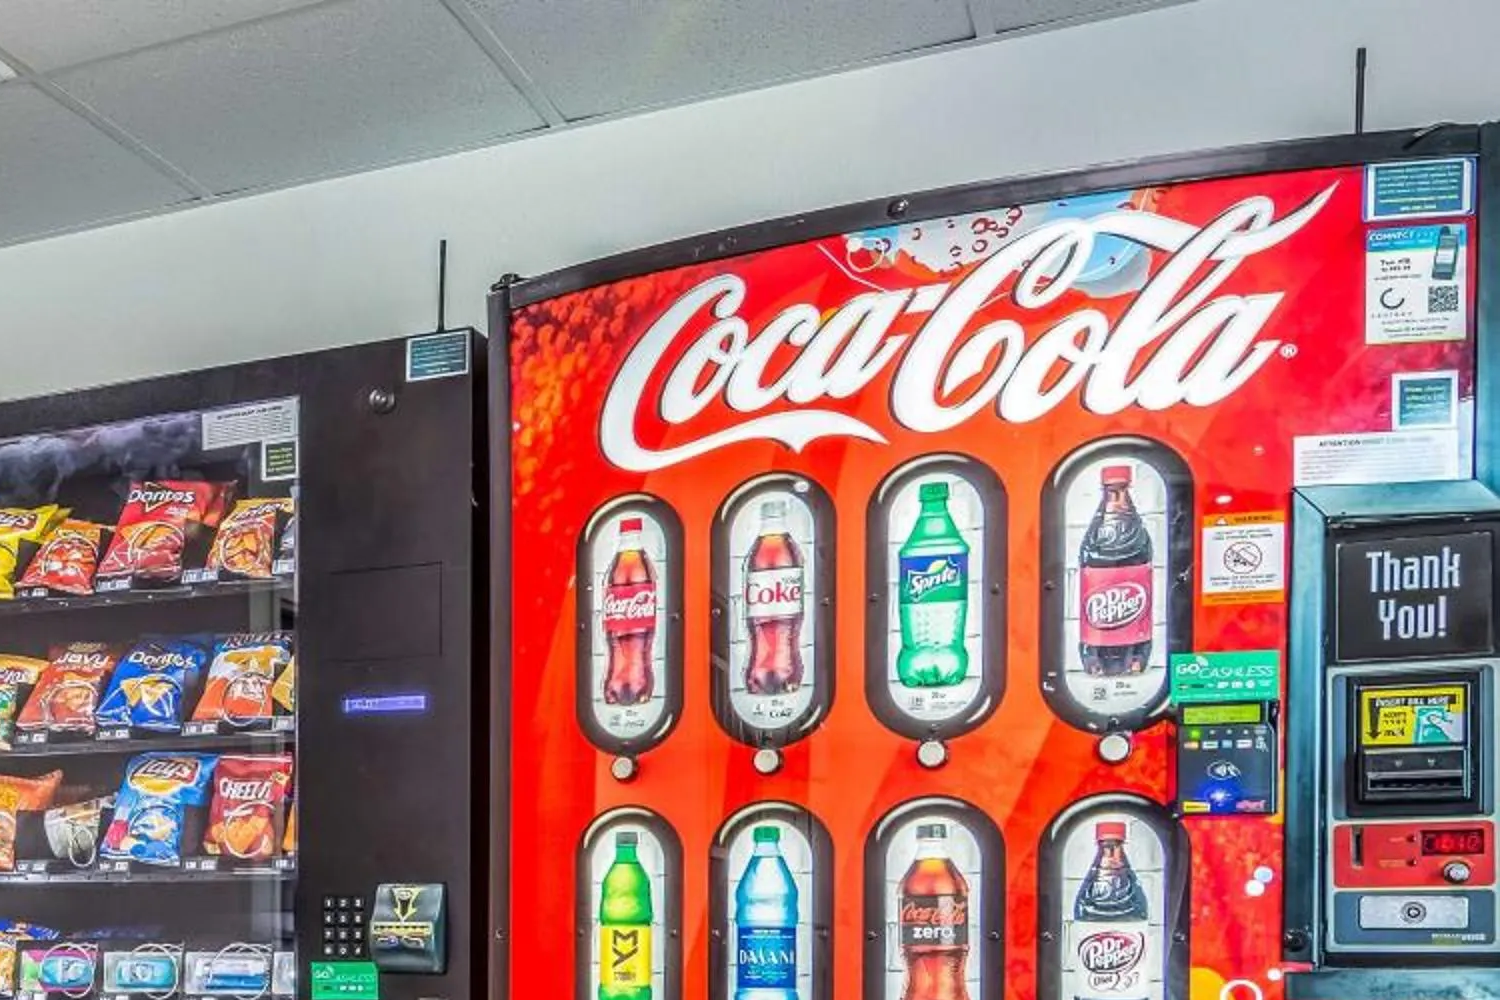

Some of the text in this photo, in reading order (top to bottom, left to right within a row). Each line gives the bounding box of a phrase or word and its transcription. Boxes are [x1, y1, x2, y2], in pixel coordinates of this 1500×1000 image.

[127, 489, 196, 505] Doritos
[1365, 545, 1461, 593] Thank
[745, 580, 802, 606] Coke
[909, 568, 958, 597] Sprite
[1377, 595, 1448, 641] You!
[128, 651, 198, 668] Doritos
[1175, 662, 1201, 676] GO
